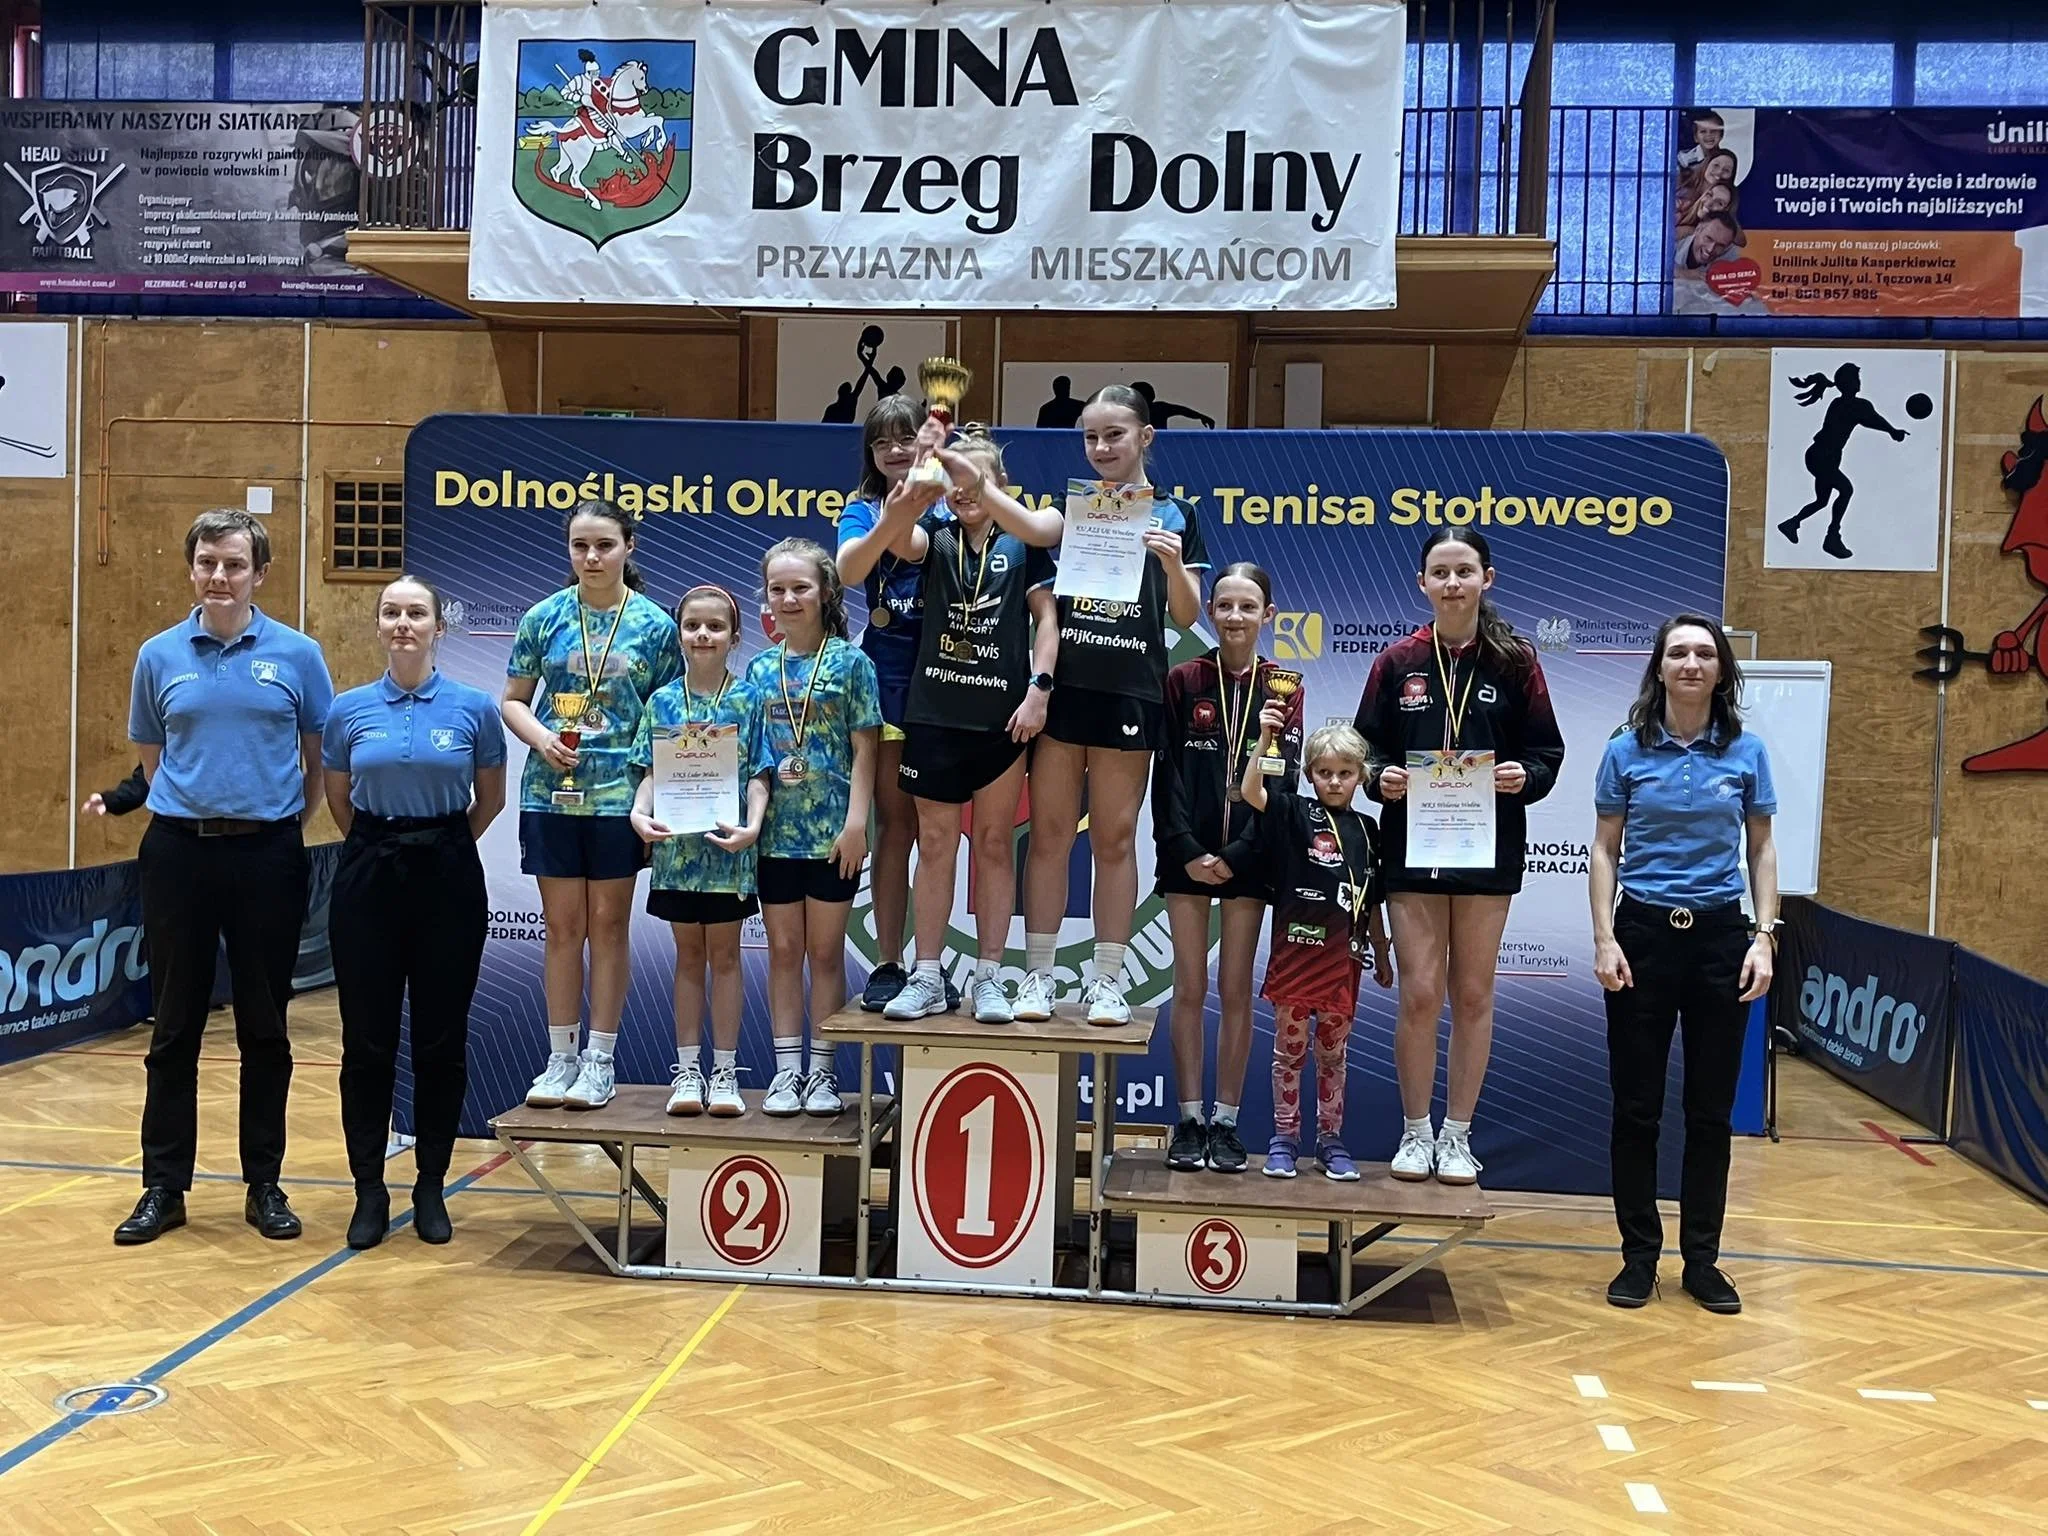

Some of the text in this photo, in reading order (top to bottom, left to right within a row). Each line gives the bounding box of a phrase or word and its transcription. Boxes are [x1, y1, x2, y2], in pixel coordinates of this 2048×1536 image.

[754, 26, 1078, 108] GMINA
[1, 111, 115, 131] WSPIERAMY
[121, 112, 211, 131] NASZYCH
[218, 112, 324, 131] SIATKARZY
[21, 146, 61, 162] HEAD
[140, 148, 198, 162] Najlepsze
[203, 148, 263, 162] rozgrywki
[140, 167, 150, 176] w
[155, 166, 209, 177] powiecie
[752, 133, 1360, 235] Brzeg Dolny
[1775, 172, 2037, 192] Ubezpieczymy życie i zdrowie
[1774, 198, 2023, 217] Twoje i Twoich najbliższych!
[144, 225, 170, 235] eventy
[143, 239, 211, 251] rozgrywki otwarte
[1772, 239, 1837, 252] Zapraszamy
[1840, 239, 1853, 249] do
[1854, 240, 1888, 252] naszej
[189, 254, 236, 265] powierzchni
[756, 237, 1353, 282] PRZYJAZNA MIESZKAŃCOM
[1772, 255, 1956, 270] Unilink Julita Kasperkiewicz
[1772, 272, 1952, 287] Brzeg Dolny, ul. Tęczowa 14
[434, 470, 713, 521] Dolnośląski
[1213, 484, 1375, 526] Tenisa
[1389, 486, 1673, 536] Stołowego
[468, 602, 526, 614] Ministerstw
[468, 616, 501, 627] Sportu
[1575, 620, 1649, 631] Ministerstwo
[1060, 627, 1147, 654] #PijKranówkę
[1575, 633, 1613, 645] Sportu
[925, 666, 1008, 692] #PijKranówkę
[1287, 935, 1325, 946] SEDA
[1519, 955, 1569, 967] Turystyki
[31, 1013, 58, 1029] table
[58, 1003, 91, 1023] tennis
[1799, 965, 1918, 1064] andro
[957, 1095, 996, 1237] 1
[723, 1170, 768, 1250] 2
[1201, 1230, 1233, 1286] 3
